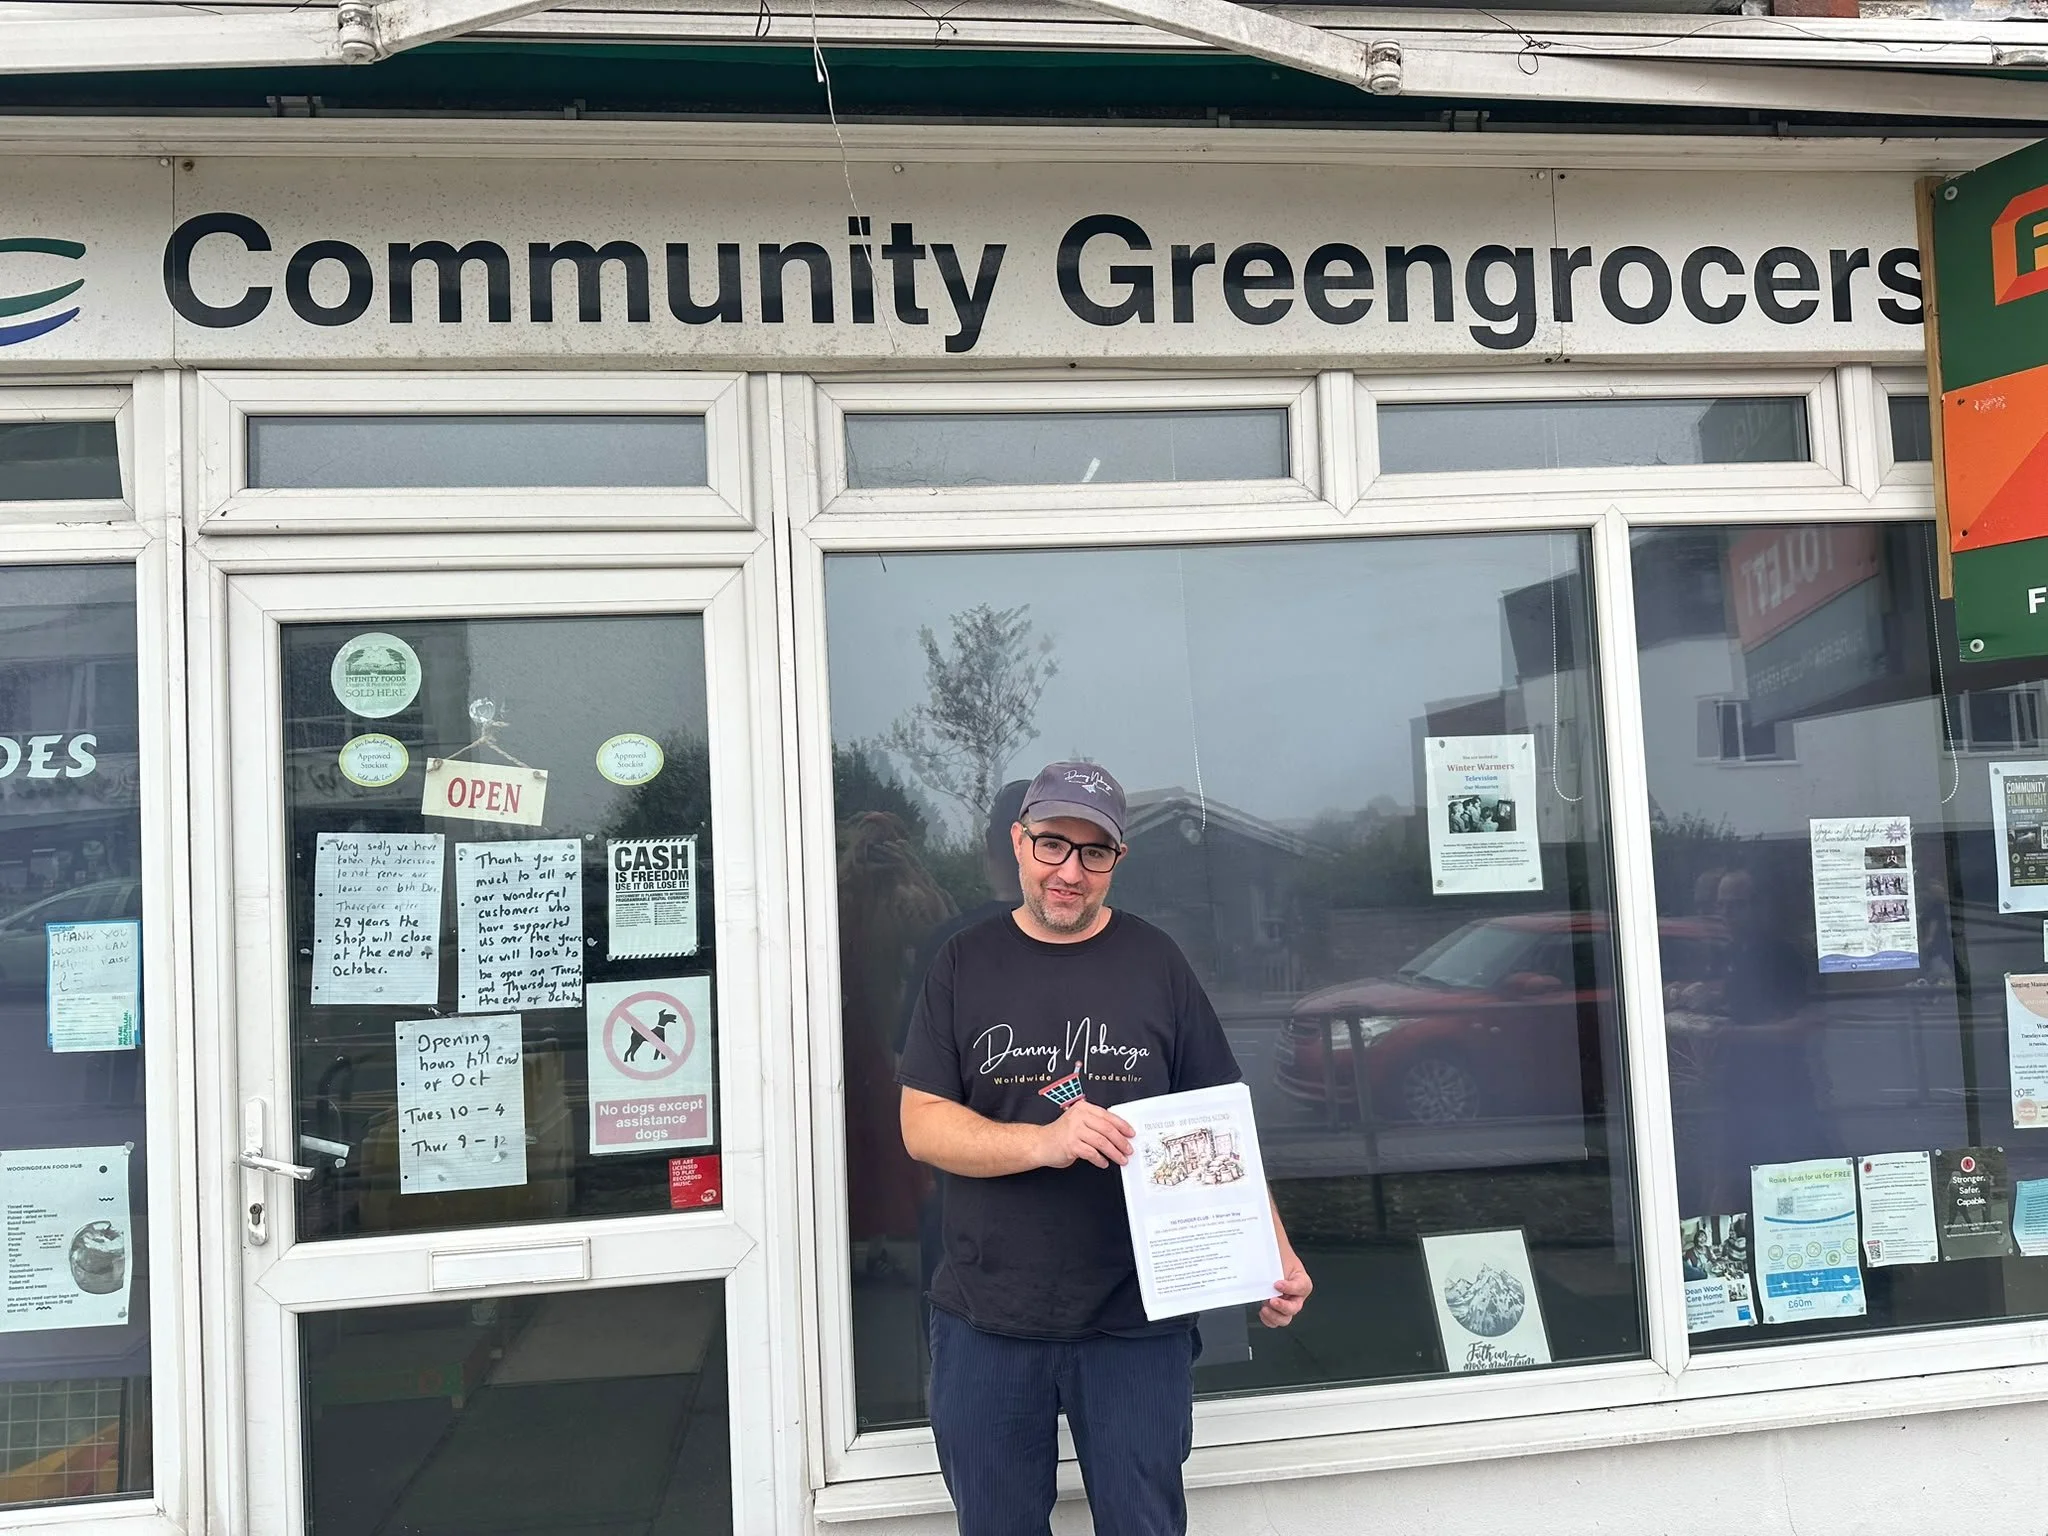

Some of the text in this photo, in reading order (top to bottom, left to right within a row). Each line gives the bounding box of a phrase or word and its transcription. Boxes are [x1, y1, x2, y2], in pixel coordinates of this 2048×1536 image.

[164, 211, 1926, 353] Community Greengrocers
[345, 688, 406, 698] SOLD HERE
[357, 752, 391, 762] Approved
[614, 752, 647, 761] Approved
[1446, 762, 1515, 772] Winter Warmers
[2006, 781, 2047, 794] COMMUNITY
[447, 776, 523, 814] OPEN
[2006, 792, 2048, 807] FILM NIGHT
[336, 840, 359, 857] Very
[397, 843, 408, 851] we
[414, 840, 437, 851] have
[370, 855, 386, 865] the
[475, 851, 576, 870] Thank you so
[614, 845, 689, 872] CASH
[351, 868, 369, 877] not
[475, 871, 509, 888] much
[518, 870, 530, 882] to
[539, 868, 555, 880] all
[615, 869, 689, 883] IS FREEDOM
[615, 880, 690, 891] USE IT OR LOSE IT!
[474, 886, 566, 904] our wonderful
[478, 899, 571, 919] customers who
[334, 914, 419, 936] 29 years the
[478, 922, 504, 934] have
[100, 927, 129, 940] YOU
[372, 931, 392, 942] will
[401, 930, 432, 943] close
[479, 937, 495, 947] us
[500, 936, 522, 945] over
[530, 931, 550, 943] the
[333, 946, 350, 960] at
[359, 945, 382, 959] the
[388, 946, 413, 957] end
[499, 949, 520, 961] will
[530, 946, 558, 959] look
[565, 946, 579, 957] to
[478, 969, 492, 979] be
[500, 970, 523, 981] open
[530, 968, 545, 976] on
[478, 981, 495, 994] and
[503, 976, 557, 995] Thursday
[478, 994, 499, 1006] the
[502, 991, 521, 1005] end
[418, 1032, 491, 1054] Opening
[973, 1016, 1150, 1075] Danny Nobrega
[496, 1052, 520, 1065] end
[451, 1069, 491, 1087] Oct
[993, 1073, 1142, 1085] Worldwide Foodseller
[404, 1103, 506, 1125] Tues 10 4
[599, 1098, 704, 1117] No dogs except
[616, 1114, 688, 1129] assistance
[635, 1128, 669, 1142] dogs
[411, 1133, 508, 1157] Thur 9 12
[672, 1163, 699, 1171] LICENSED
[672, 1174, 703, 1182] RECORDED
[1788, 1175, 1804, 1183] funds
[1805, 1173, 1814, 1181] for
[1834, 1170, 1852, 1178] FREE
[1952, 1175, 1987, 1185] Stronger.
[1959, 1186, 1981, 1195] Safer.
[1956, 1197, 1987, 1207] Capable.
[1685, 1285, 1723, 1296] Dean Wood
[1686, 1295, 1702, 1303] Care
[1788, 1299, 1813, 1309] £60m
[1466, 1341, 1496, 1362] Faith
